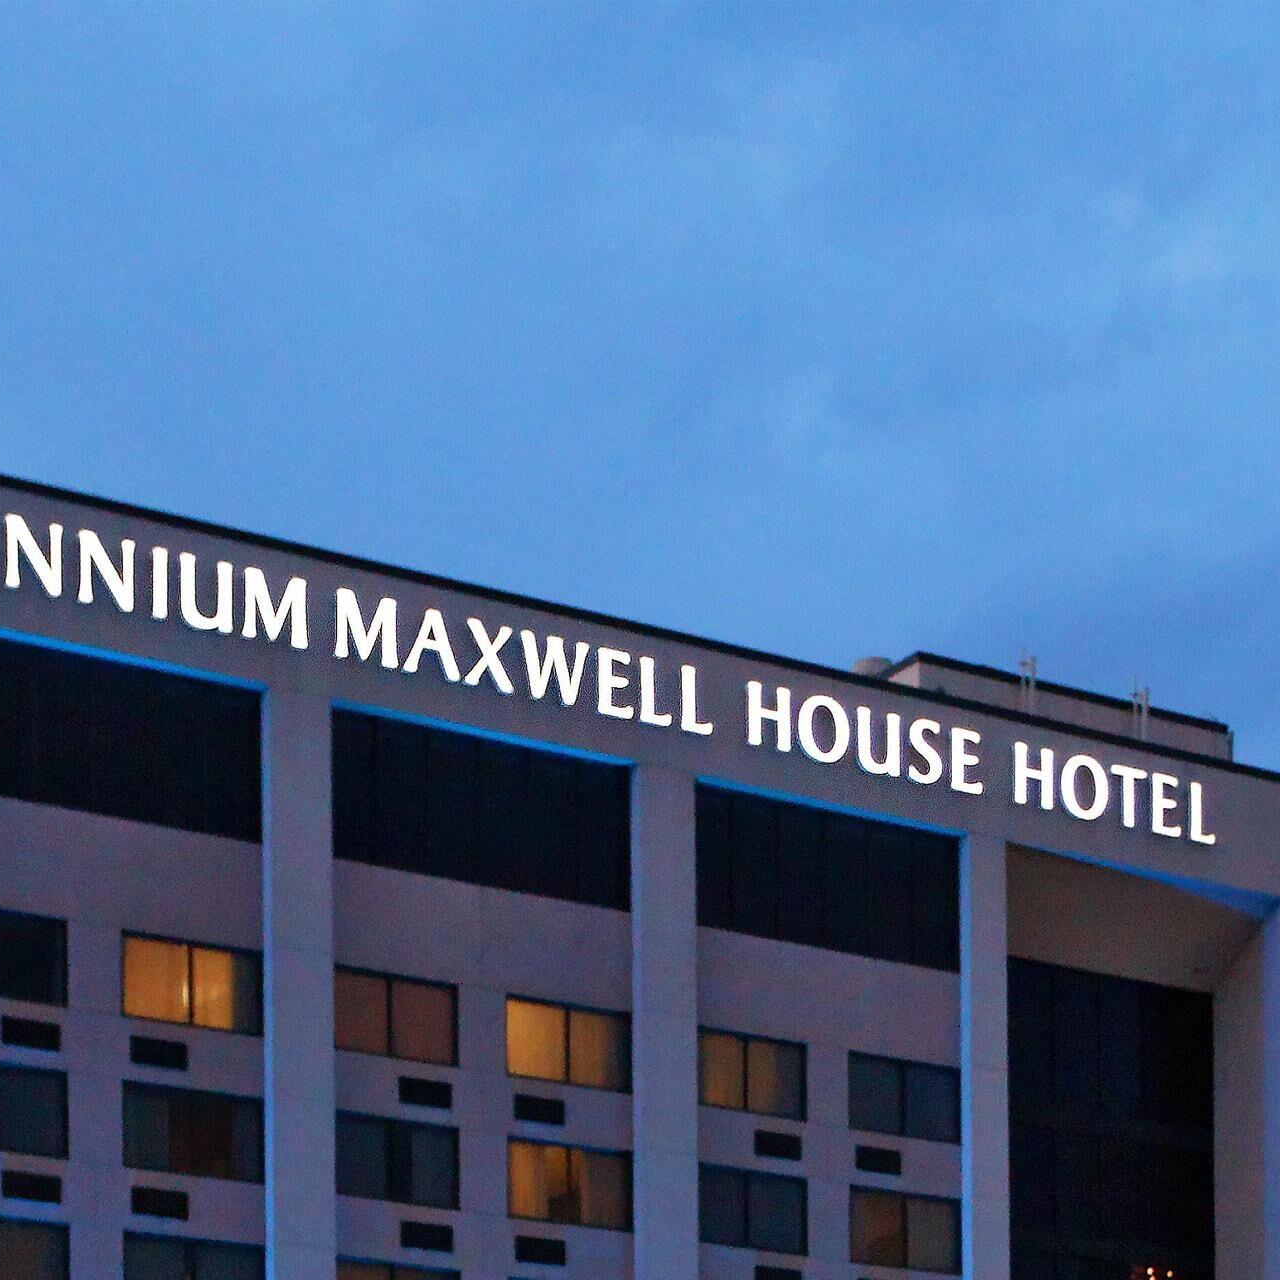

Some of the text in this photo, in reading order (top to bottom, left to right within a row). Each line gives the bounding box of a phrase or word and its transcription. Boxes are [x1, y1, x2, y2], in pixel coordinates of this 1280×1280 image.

[333, 586, 716, 737] MAXWELL
[746, 679, 985, 796] HOUSE
[1013, 740, 1217, 847] HOTEL
